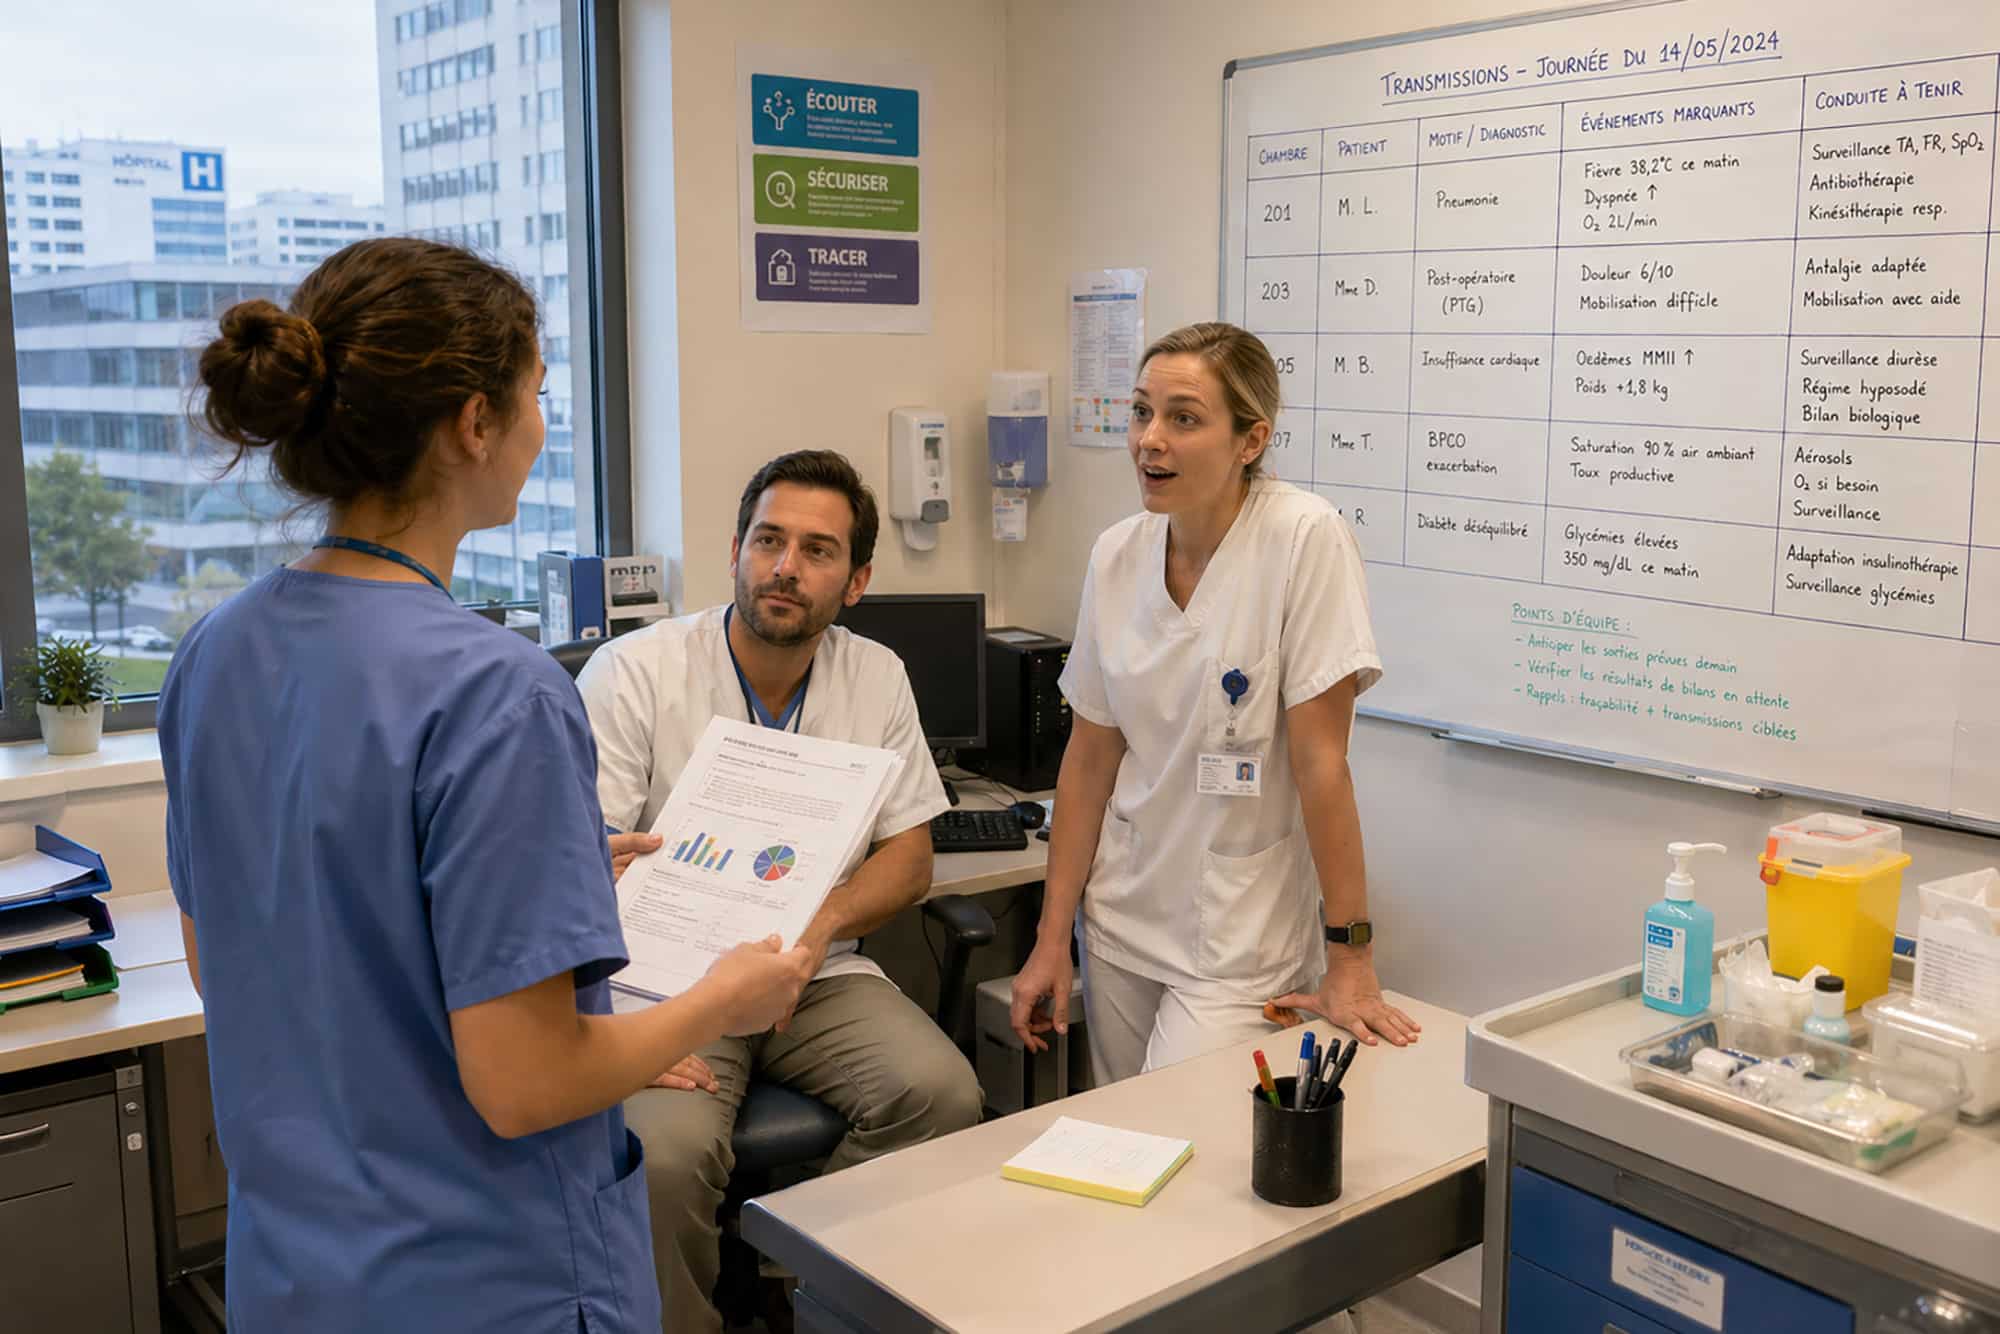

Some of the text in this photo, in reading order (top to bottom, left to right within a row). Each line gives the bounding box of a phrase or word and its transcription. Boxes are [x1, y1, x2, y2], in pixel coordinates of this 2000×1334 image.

[1380, 65, 1508, 96] TRANSMISSIONS
[1537, 48, 1608, 78] JOURNÉE
[1624, 49, 1645, 67] DU
[1659, 28, 1779, 72] 14/05/2024
[806, 88, 877, 114] ÉCOUTER
[1816, 80, 1963, 110] CONDUITE À TENIR
[1581, 102, 1755, 132] ÉVÉNEMENTS MARQUANTS
[1429, 131, 1463, 147] MOTIF
[1481, 124, 1546, 141] DIAGNOSTIC
[1259, 147, 1307, 165] CHAMBRE
[1338, 139, 1387, 156] PATIENT
[1813, 142, 1891, 160] Surveillance
[1896, 136, 1918, 155] TA,
[1923, 134, 1945, 153] FR,
[112, 153, 173, 171] HÔPITAL
[189, 155, 216, 188] H
[1585, 162, 1621, 178] Fièvre
[1682, 161, 1694, 170] ce
[1704, 154, 1739, 168] matin
[808, 167, 889, 192] SÉCURISER
[1810, 171, 1914, 192] Antibiothérapie
[1338, 196, 1377, 217] M. L.
[1437, 191, 1498, 208] Pneumonie
[1585, 189, 1637, 210] Dyspnée
[1264, 204, 1291, 222] 201
[1609, 212, 1657, 231] 2L/min
[1809, 203, 1946, 224] Kinésithérapie resp.
[808, 248, 868, 266] TRACER
[1427, 269, 1515, 290] Post-opératoire
[1582, 261, 1673, 283] Douleur 6/10
[1805, 257, 1926, 282] Antalgie adaptée
[1262, 282, 1289, 300] 203
[1364, 279, 1378, 296] D.
[1804, 289, 1960, 306] Mobilisation avec aide
[1443, 296, 1483, 316] (PTG)
[1580, 295, 1656, 309] Mobilisation
[1278, 357, 1294, 374] 05
[1334, 356, 1373, 374] M. B.
[1490, 352, 1539, 371] cardiaque
[1643, 351, 1674, 365] MMII
[1801, 349, 1937, 366] Surveillance diurèse
[1576, 377, 1606, 393] Poids
[1653, 379, 1668, 402] kg
[1803, 377, 1926, 402] Régime hyposodé
[1802, 404, 1920, 431] Bilan biologique
[1361, 433, 1373, 450] T.
[1429, 431, 1465, 448] BPCO
[1571, 436, 1634, 454] Saturation
[1682, 446, 1698, 457] air
[1707, 446, 1754, 460] ambiant
[1794, 446, 1852, 465] Aérosols
[1427, 459, 1497, 474] exacerbation
[1570, 462, 1674, 485] Toux productive
[1818, 478, 1827, 490] si
[1837, 476, 1878, 492] besoin
[1794, 500, 1880, 521] Surveillance
[1464, 519, 1527, 541] déséquilibré
[1565, 524, 1678, 549] Glycémies élevées
[1564, 551, 1699, 578] 350 mg/dL ce matin
[1787, 544, 1958, 581] Adaptation insulinothérapie
[1786, 573, 1934, 606] Surveillance glycémies
[1512, 603, 1554, 621] POINTS
[1528, 634, 1574, 656] Anticiper
[1582, 640, 1596, 655] les
[1603, 645, 1638, 660] sorties
[1646, 650, 1687, 668] prévues
[1696, 656, 1736, 672] demain
[1528, 660, 1571, 680] Vérifier
[1580, 664, 1594, 680] les
[1603, 671, 1653, 688] résultats
[1660, 677, 1674, 692] de
[1682, 681, 1716, 698] bilans
[1724, 692, 1737, 701] en
[1746, 691, 1789, 709] attente
[1527, 683, 1565, 705] Rappels
[1580, 692, 1638, 714] traçabilité
[1663, 704, 1743, 731] transmissions
[1753, 721, 1796, 741] ciblées
